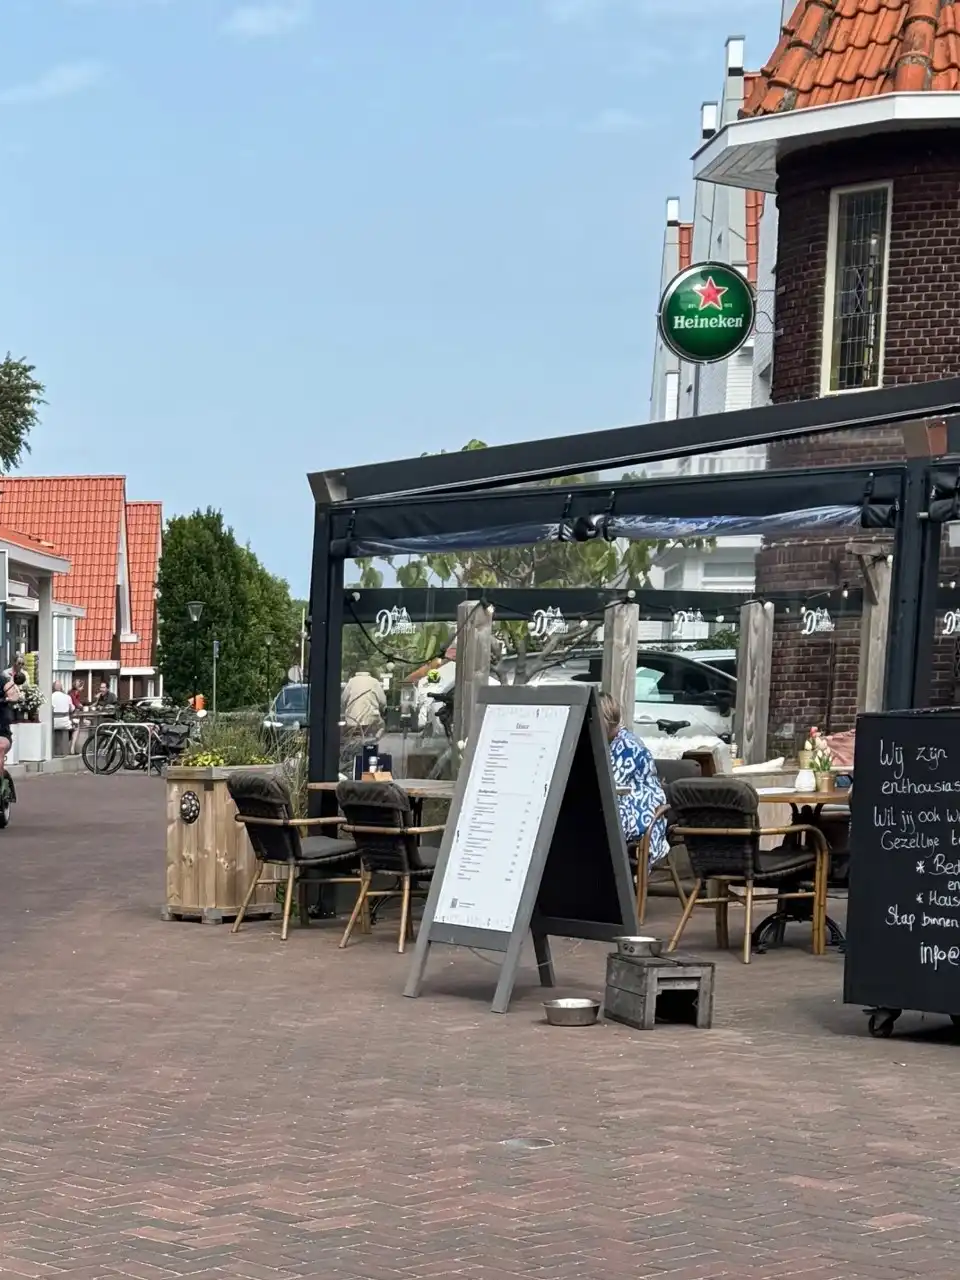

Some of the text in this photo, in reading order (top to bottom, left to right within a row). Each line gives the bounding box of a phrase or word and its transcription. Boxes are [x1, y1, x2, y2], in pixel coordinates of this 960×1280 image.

[673, 314, 744, 329] Heineken
[880, 739, 948, 780] Wij zijn
[874, 806, 897, 827] Wil
[900, 810, 916, 835] jij
[918, 806, 941, 823] ook
[885, 903, 916, 932] Stap
